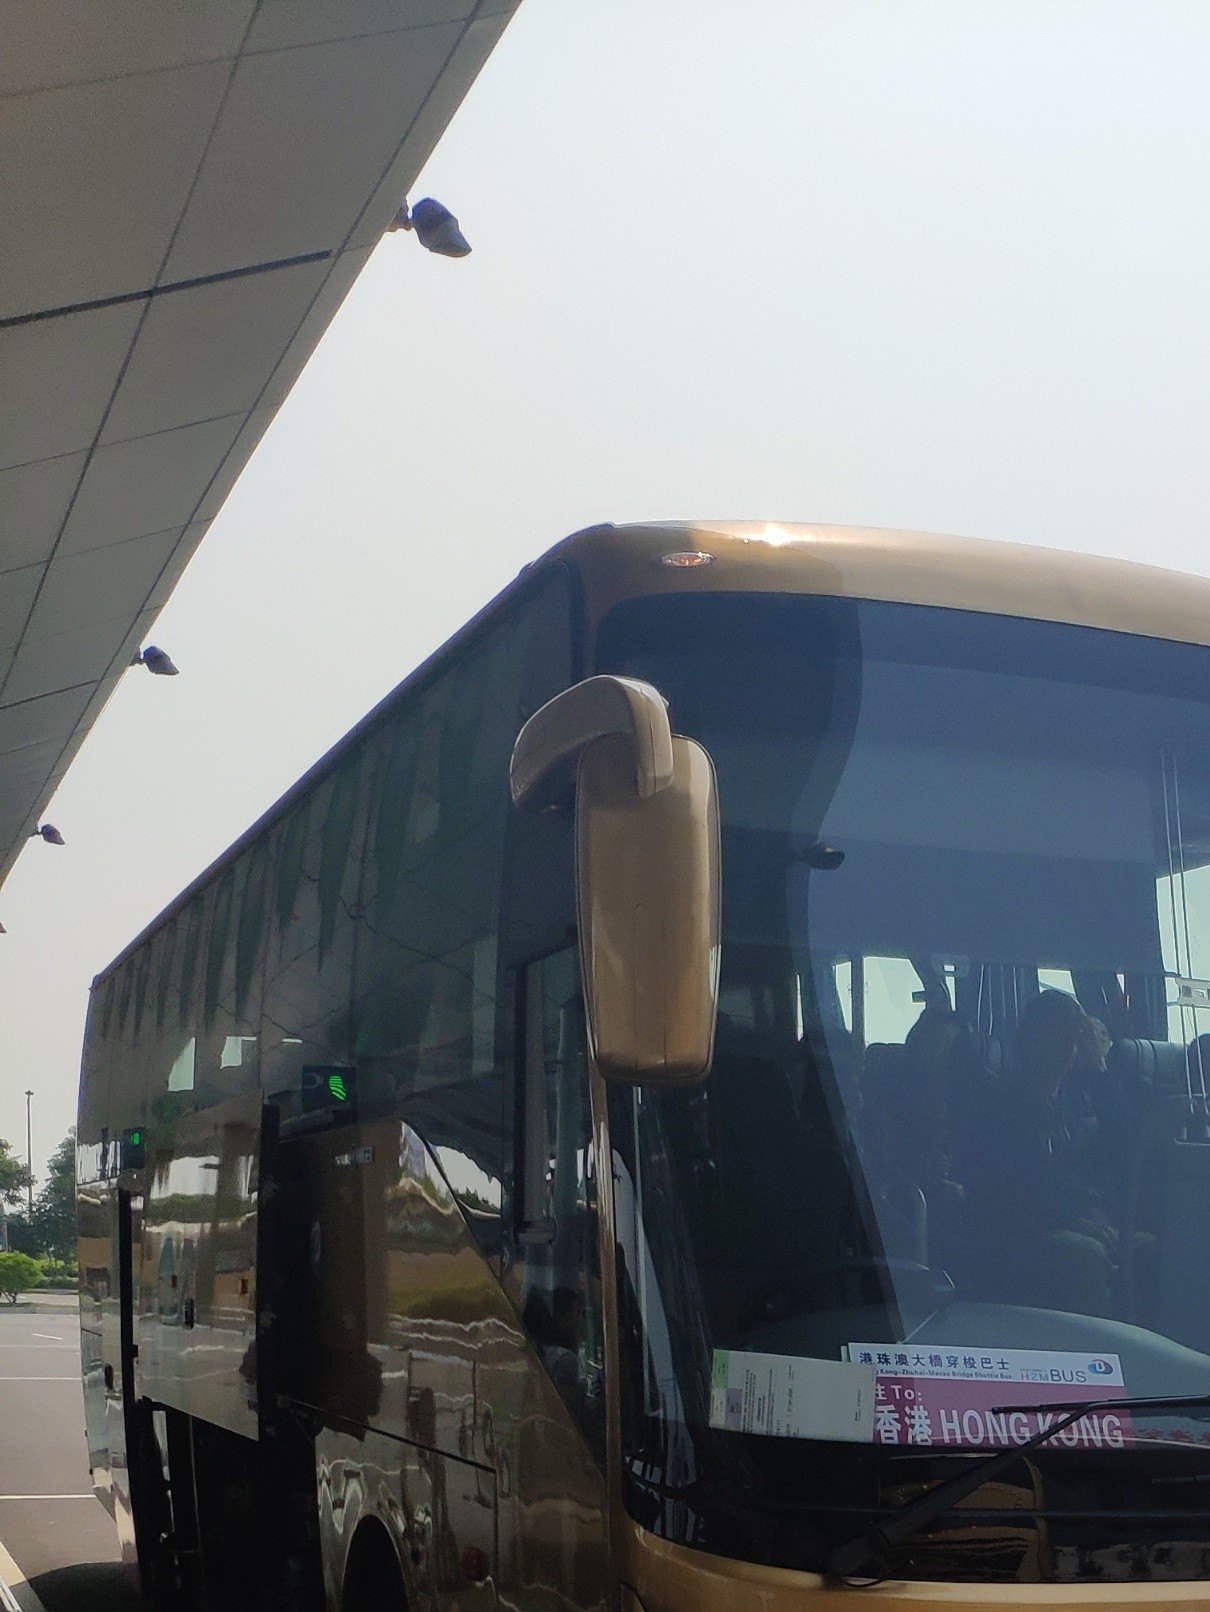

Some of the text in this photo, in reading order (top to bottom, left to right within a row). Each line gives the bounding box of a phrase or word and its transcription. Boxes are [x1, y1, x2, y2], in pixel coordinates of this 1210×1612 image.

[859, 1352, 1010, 1370] 港珠澳大橋穿梭巴士
[952, 1370, 974, 1379] Bridge
[975, 1371, 999, 1379] Shuttle
[890, 1384, 923, 1401] To:
[876, 1405, 933, 1446] 香港
[939, 1409, 1031, 1446] HONG
[1037, 1412, 1125, 1448] KONG
